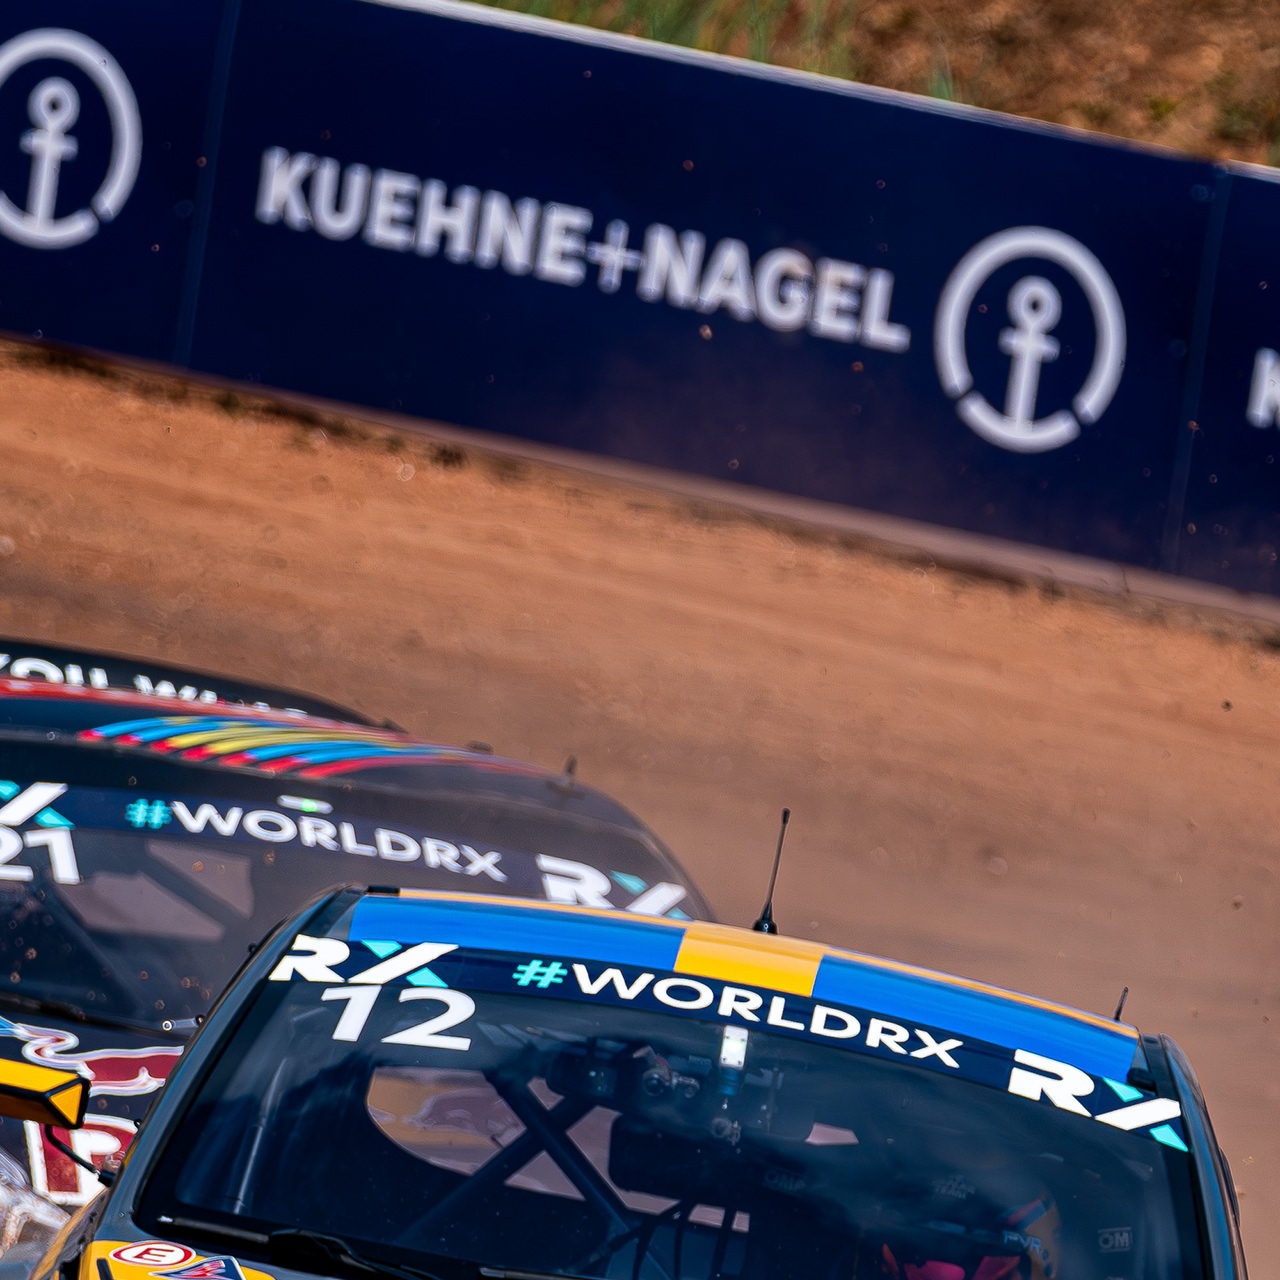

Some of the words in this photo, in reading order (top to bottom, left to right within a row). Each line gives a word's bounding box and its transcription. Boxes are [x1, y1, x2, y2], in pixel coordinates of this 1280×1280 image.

[257, 146, 911, 352] KUEHNE+NAGEL
[125, 798, 508, 883] #WORLDRX
[534, 853, 694, 923] RX
[268, 934, 460, 988] RX
[320, 984, 476, 1051] 12
[512, 958, 963, 1069] #WORLDRX
[1007, 1048, 1189, 1152] RX
[133, 1246, 176, 1264] E
